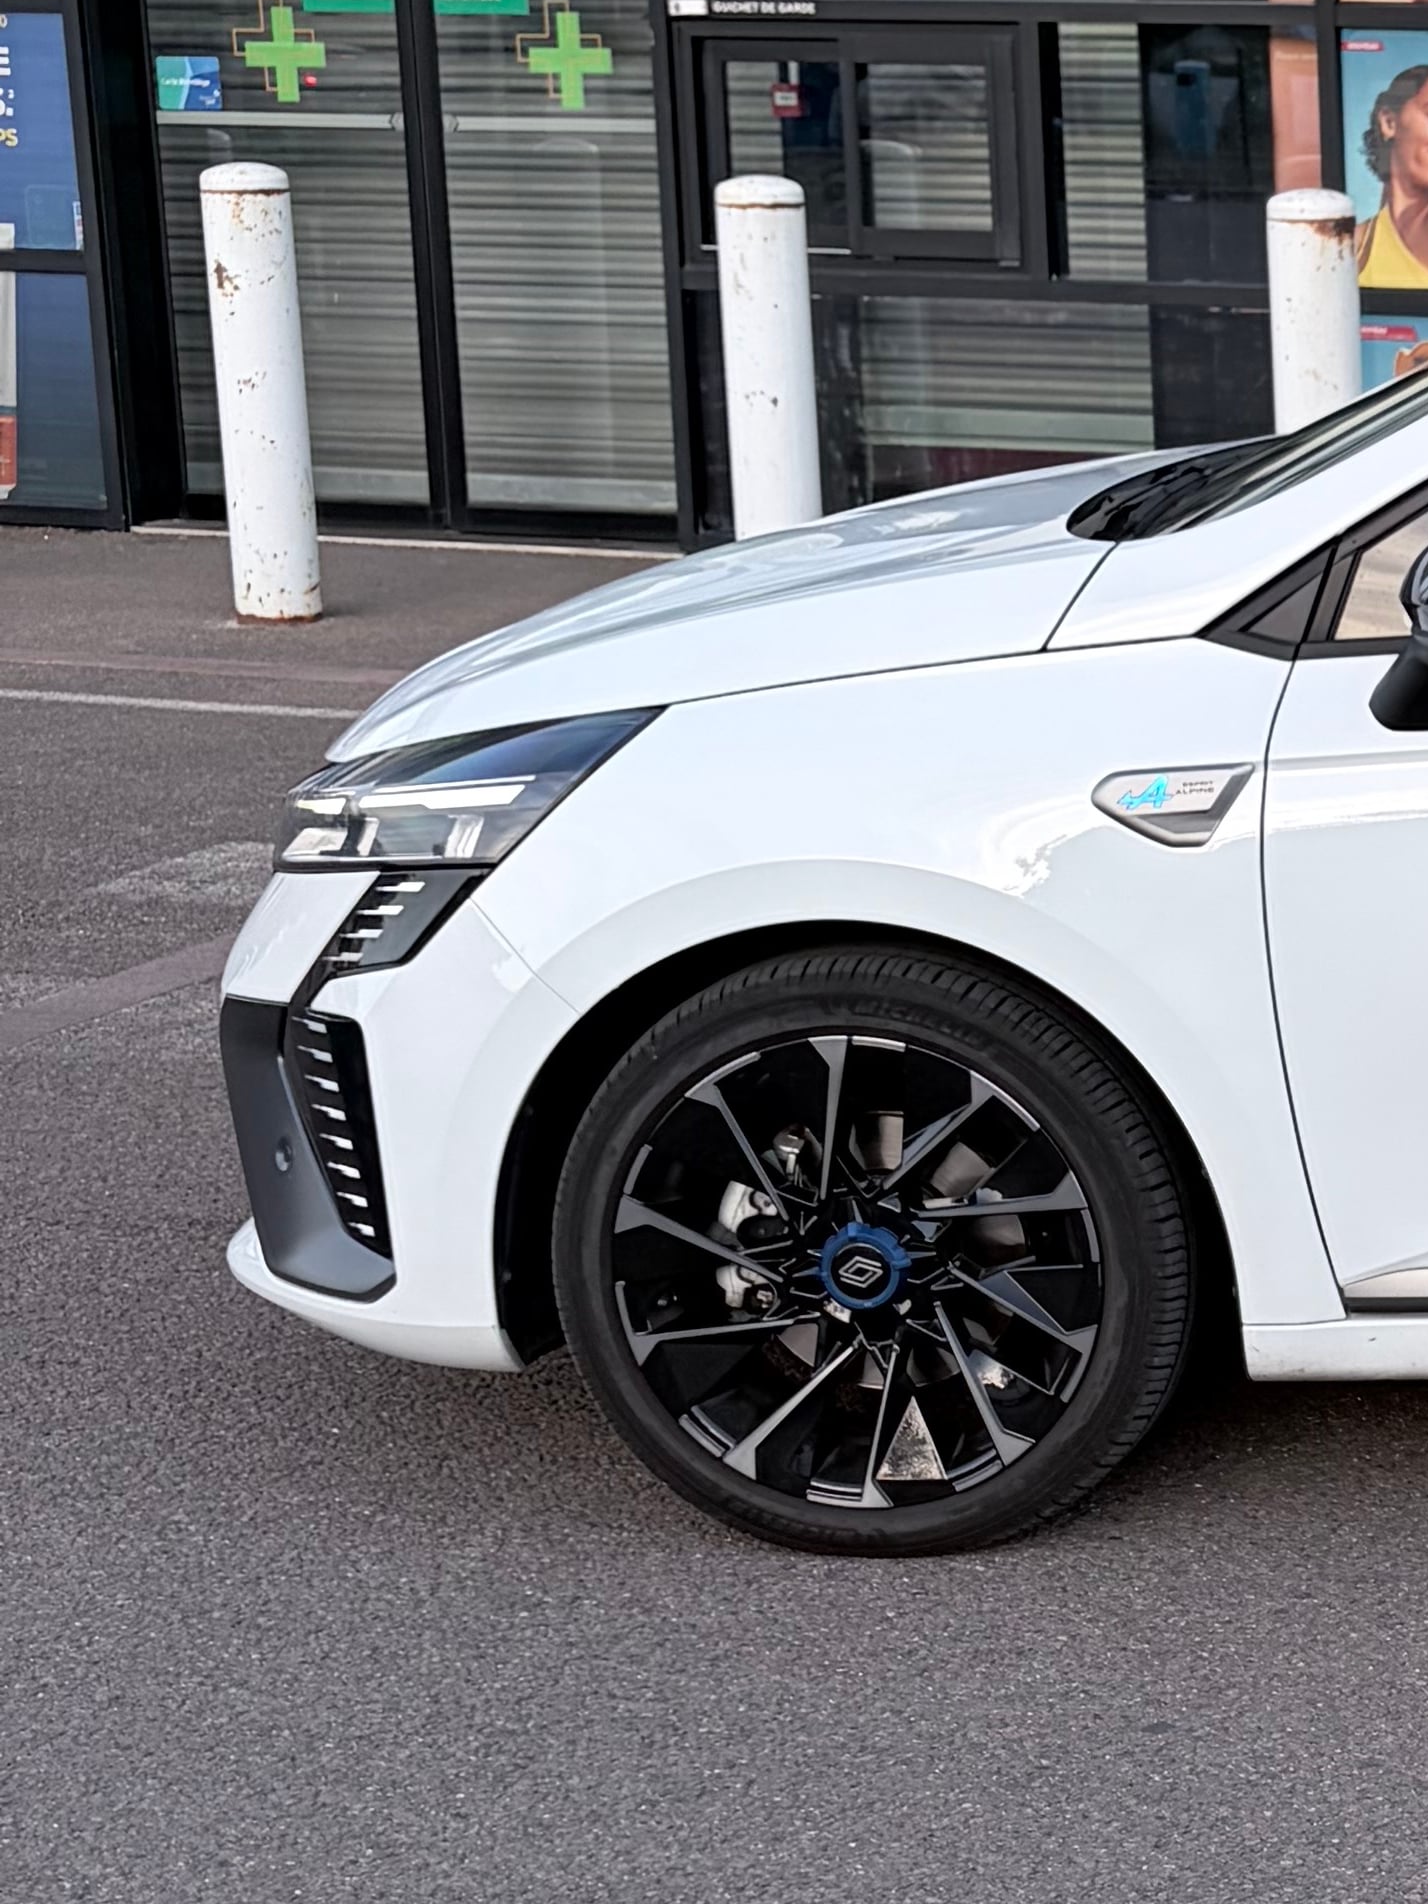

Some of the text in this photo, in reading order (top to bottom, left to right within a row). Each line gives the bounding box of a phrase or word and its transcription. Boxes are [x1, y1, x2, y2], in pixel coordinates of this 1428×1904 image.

[712, 0, 817, 15] GUICHET DE GARDE
[1176, 787, 1215, 795] ALPINE
